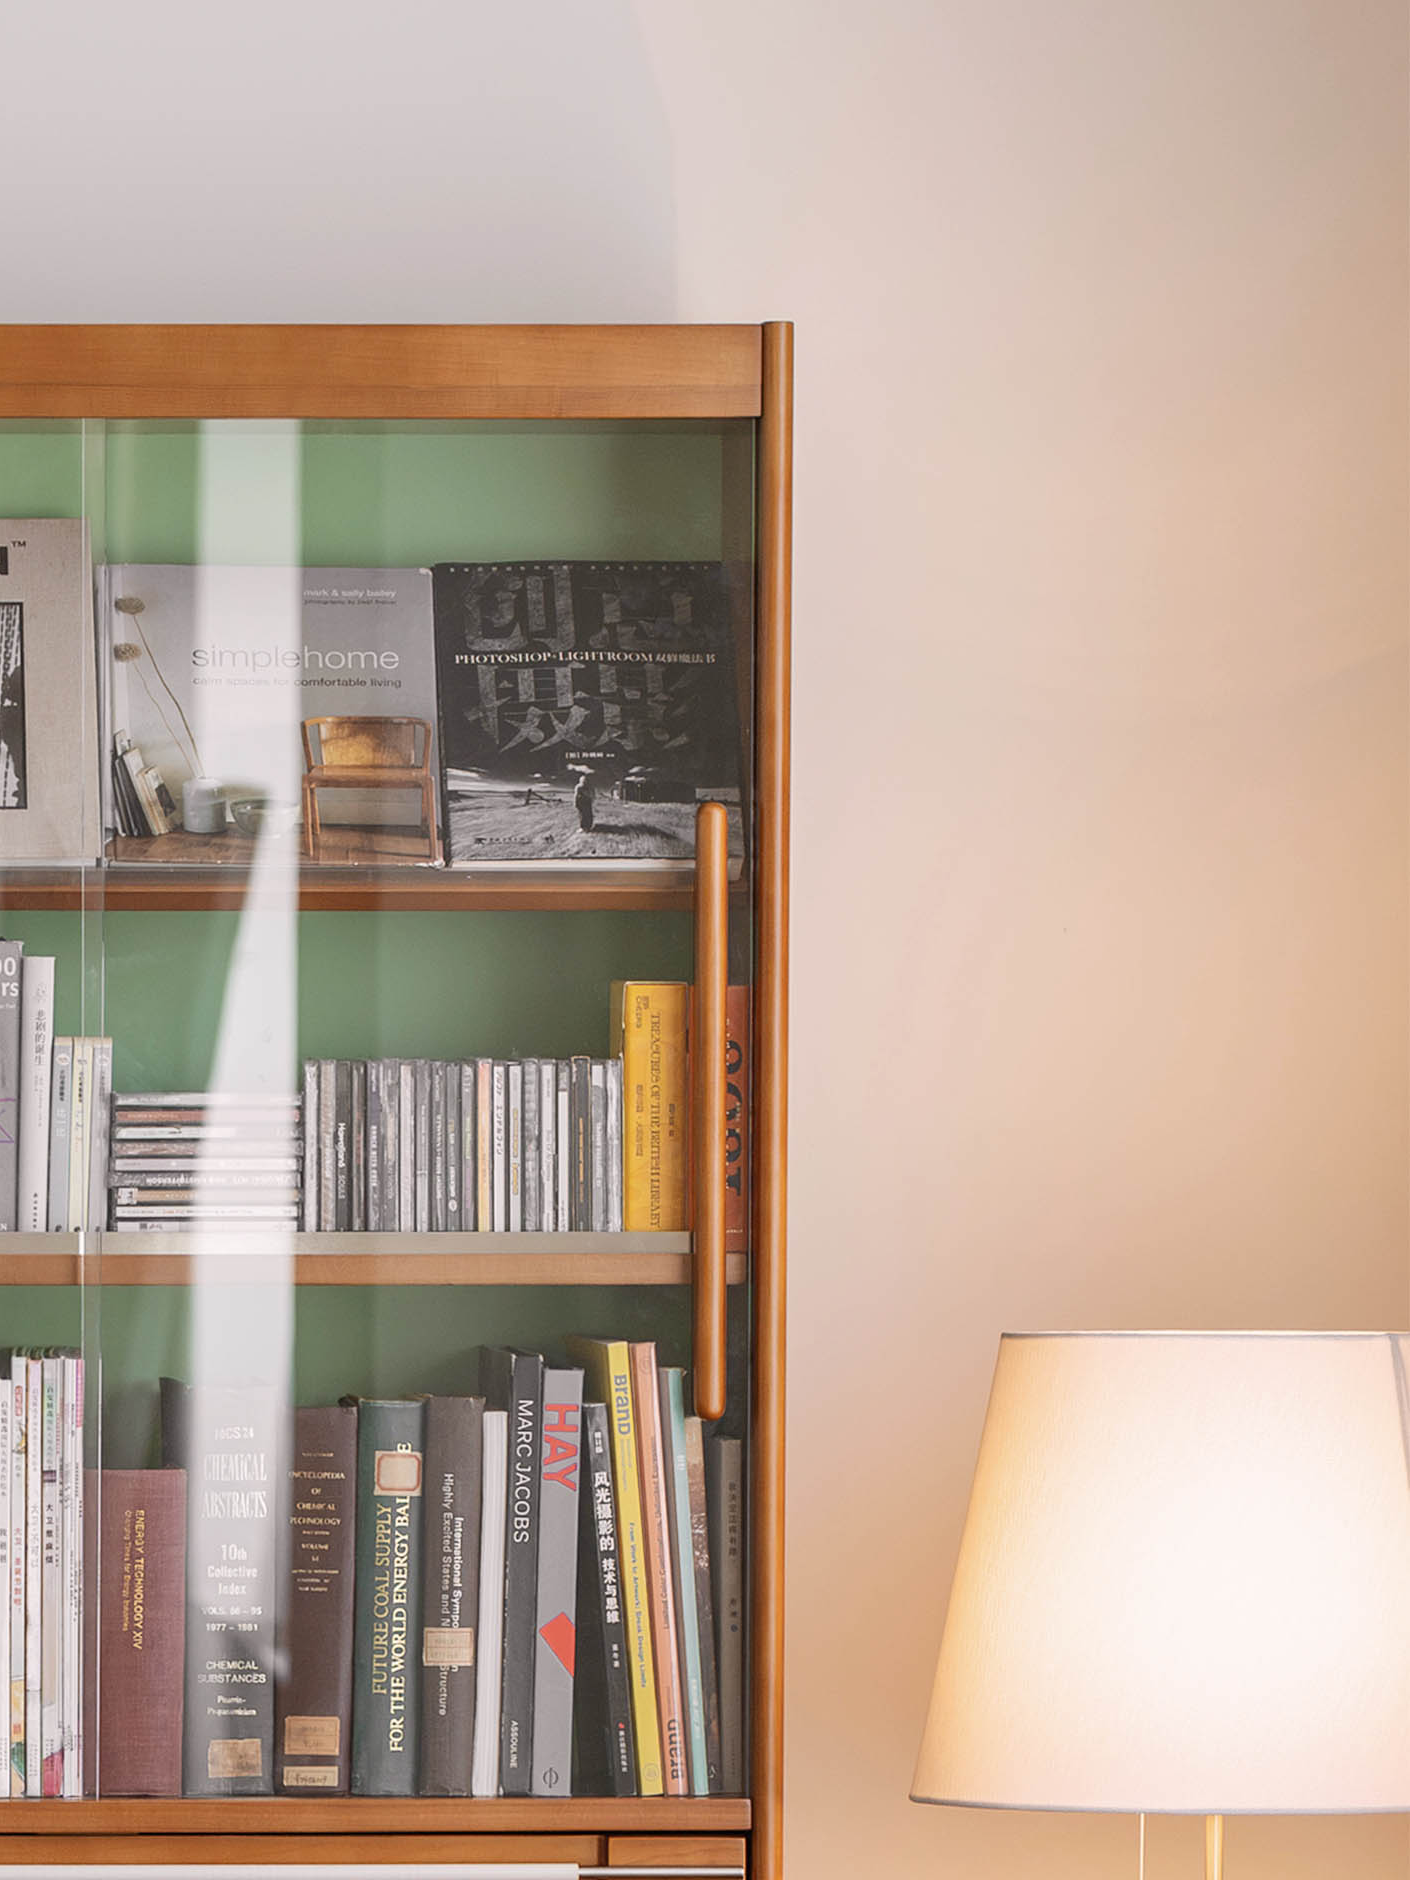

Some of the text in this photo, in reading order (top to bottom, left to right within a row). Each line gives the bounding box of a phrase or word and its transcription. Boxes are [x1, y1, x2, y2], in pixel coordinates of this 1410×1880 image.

[192, 645, 400, 673] simplehome
[294, 676, 367, 687] comfortable
[370, 676, 402, 689] living
[650, 1012, 661, 1082] TREASURES
[650, 1085, 661, 1100] OF
[650, 1104, 661, 1128] THE
[650, 1178, 661, 1228] LIBRARY
[203, 1453, 268, 1481] CHEMICAL
[542, 1402, 578, 1493] HAY
[512, 1399, 534, 1543] MARC JACOBS
[201, 1490, 268, 1519] ABSTRACTS
[296, 1501, 336, 1511] CHEMICAL
[594, 1470, 615, 1552] 风光摄影的
[220, 1543, 247, 1561] 10th
[441, 1473, 454, 1614] Highly Excited States and
[451, 1516, 464, 1587] International
[132, 1509, 145, 1650] ENERGY TECHNOLOGY XIV
[207, 1565, 258, 1578] Collective
[393, 1531, 410, 1604] ENERGY
[218, 1582, 247, 1596] Index
[372, 1503, 392, 1695] FUTURE COAL SUPPLY
[601, 1557, 620, 1625] 技术与思维
[391, 1607, 408, 1673] WORLD
[198, 1673, 267, 1683] SUBSTANCES
[205, 1660, 259, 1670] CHEMICAL
[390, 1676, 406, 1715] THE
[389, 1716, 405, 1752] FOR
[509, 1719, 519, 1768] ASSOULINE
